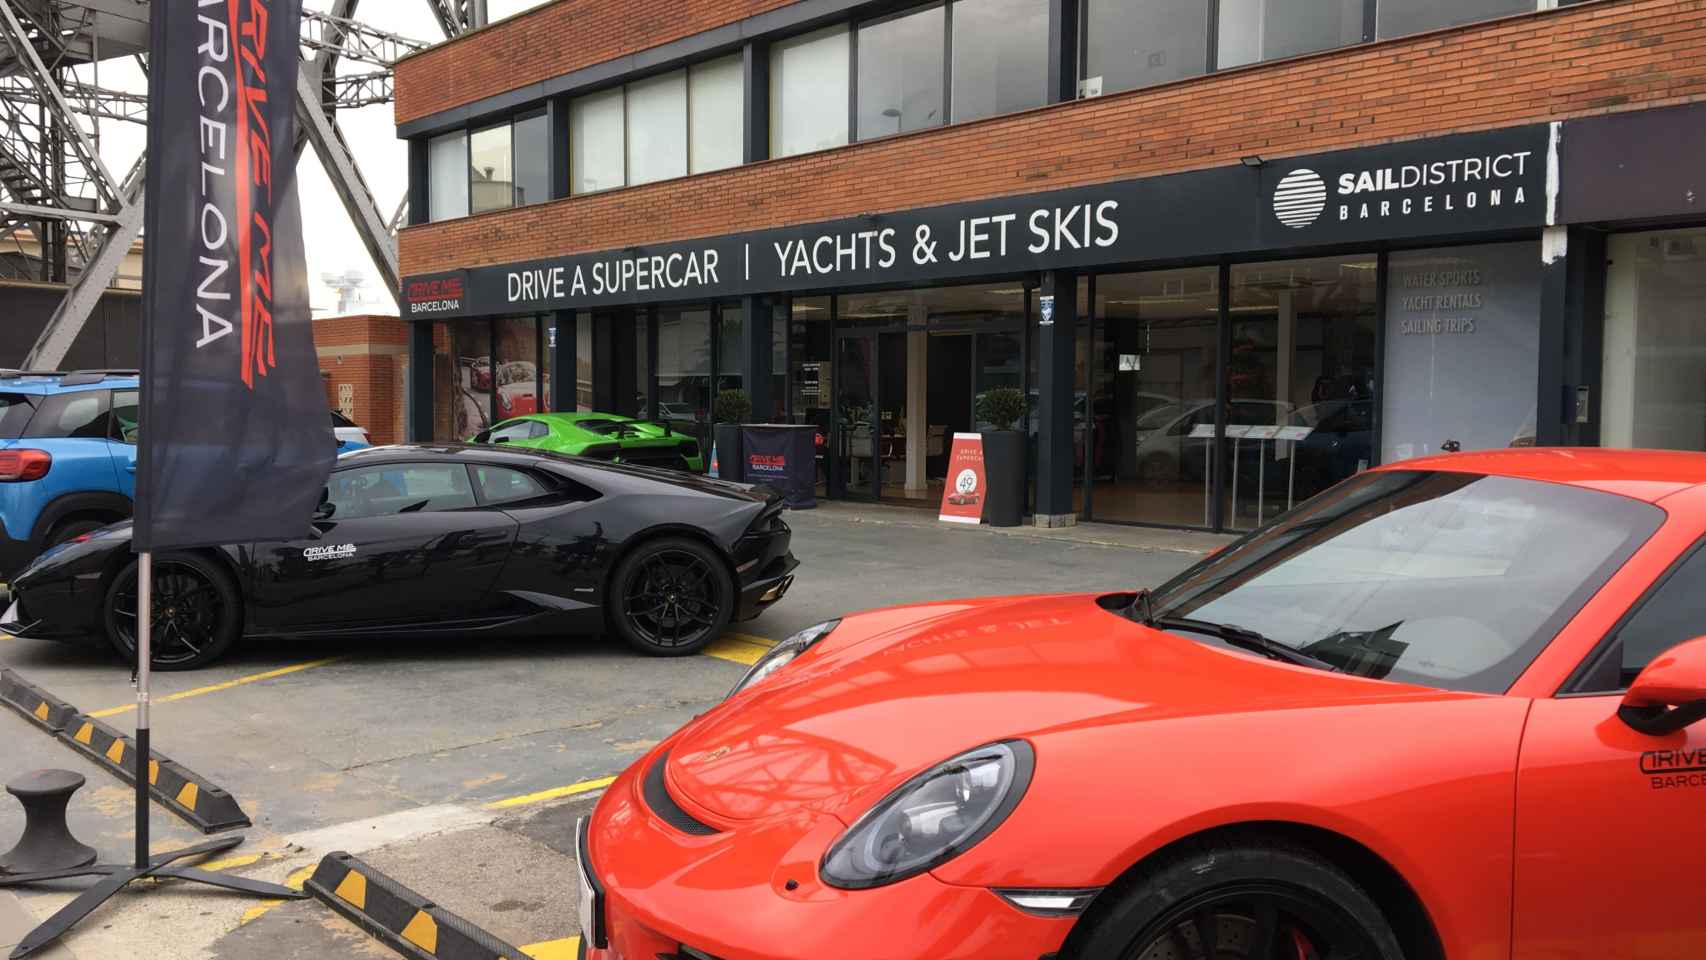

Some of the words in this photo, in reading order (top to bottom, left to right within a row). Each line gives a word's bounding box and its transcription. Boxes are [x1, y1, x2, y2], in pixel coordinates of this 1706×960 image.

[196, 0, 233, 348] RCELONA
[1339, 186, 1526, 221] BARCELONA
[774, 228, 896, 277] YACHTS
[912, 224, 938, 265] &
[948, 213, 1017, 262] JET
[1027, 200, 1119, 254] SKIS
[507, 267, 565, 302] DRIVE
[570, 265, 587, 297] A
[592, 249, 720, 295] SUPERCAR
[1402, 272, 1437, 288] WATER
[1439, 270, 1481, 286] SPORTS
[411, 299, 460, 313] BARCELONA
[1401, 295, 1434, 311] YACHT
[1436, 293, 1481, 310] RENTALS
[1400, 319, 1441, 335] SAILING
[1444, 317, 1475, 334] TRIPS
[959, 477, 973, 490] 49
